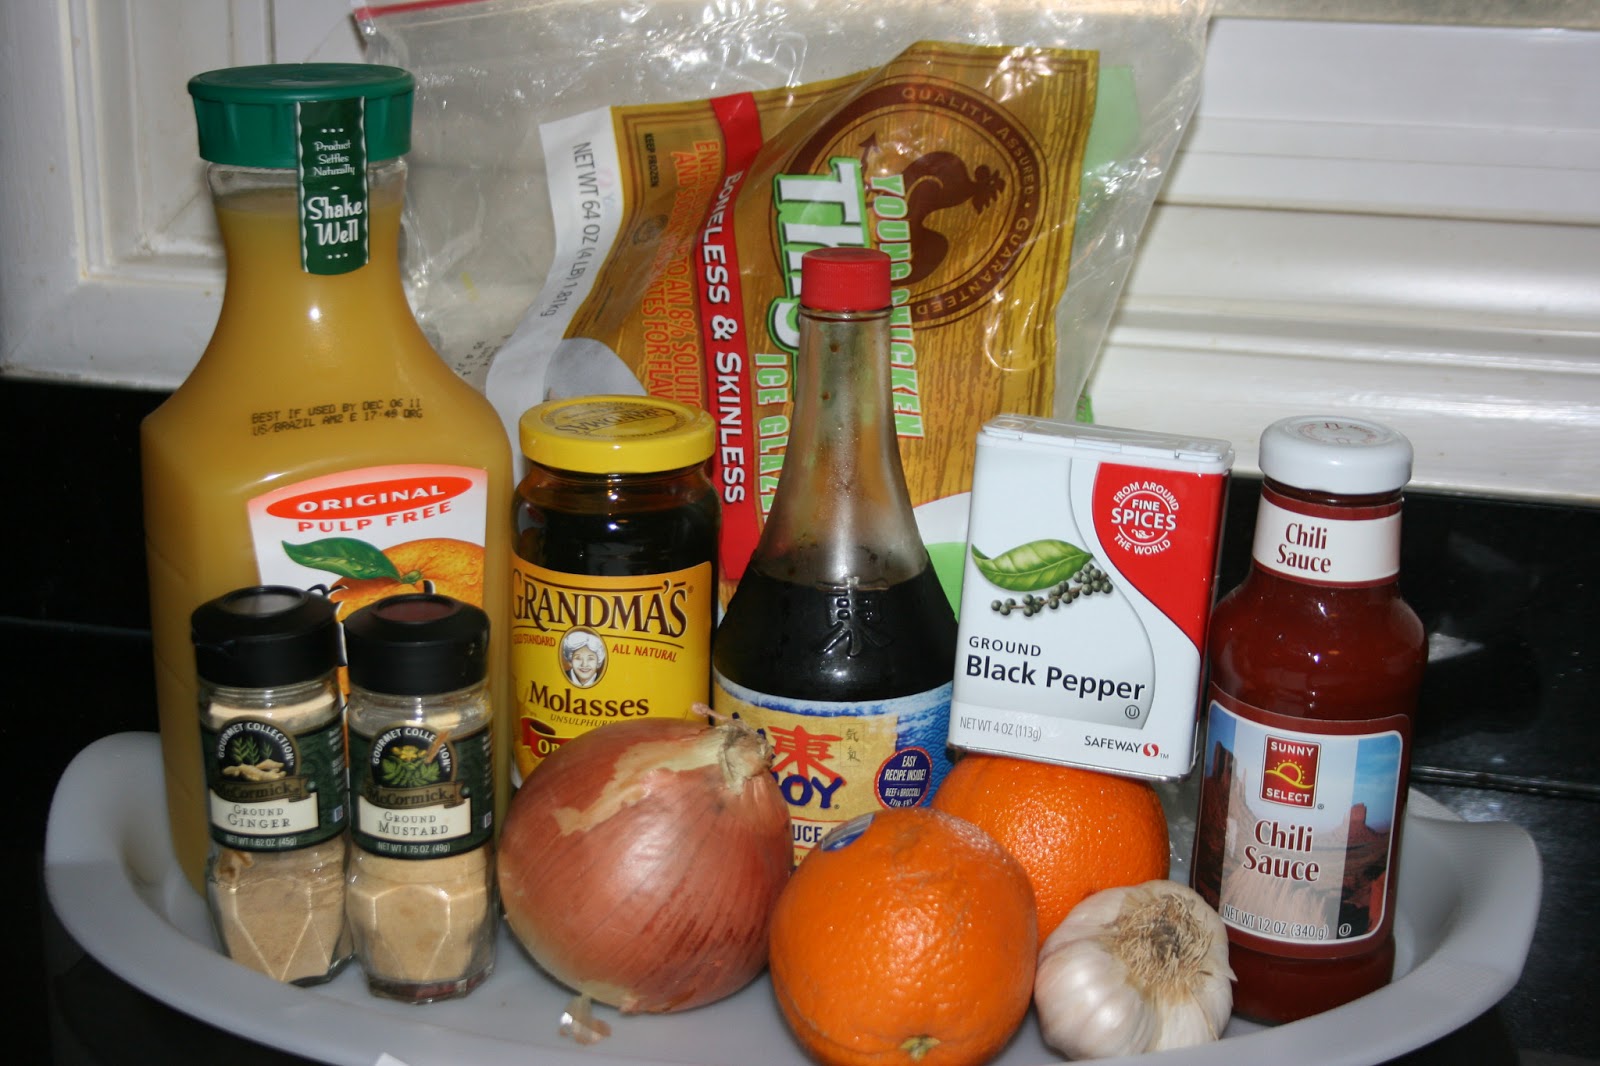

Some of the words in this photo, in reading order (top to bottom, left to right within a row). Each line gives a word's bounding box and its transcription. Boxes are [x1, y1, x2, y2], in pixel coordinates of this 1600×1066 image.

[313, 140, 351, 152] Product
[573, 142, 595, 168] NET
[644, 133, 656, 155] KEEP
[902, 86, 992, 123] QUALITY
[997, 126, 1035, 198] ASSURED
[313, 163, 356, 178] Naturally
[317, 153, 350, 166] Settles
[648, 155, 660, 188] FROZEN
[671, 151, 698, 187] AND
[578, 171, 599, 195] WT
[307, 194, 363, 221] Shake
[582, 200, 601, 220] 64
[313, 218, 359, 246] Well
[583, 225, 601, 248] OZ
[703, 170, 743, 304] BONELESS
[871, 175, 912, 282] YOUNG
[667, 255, 689, 276] TO
[916, 216, 1030, 315] GUARANTEED
[666, 279, 691, 304] AN
[668, 309, 696, 338] 8%
[711, 314, 739, 341] &
[643, 321, 671, 357] FOR
[672, 342, 702, 408] SOLUTI
[890, 289, 925, 438] CHICKEN
[647, 359, 671, 398] FLAV
[755, 353, 787, 406] ICE
[252, 410, 281, 424] BEST
[288, 408, 301, 420] IF
[308, 404, 336, 417] USED
[342, 403, 357, 413] BY
[362, 400, 384, 411] DEC
[715, 351, 747, 504] SKINLESS
[759, 415, 790, 523] GLAZ
[297, 485, 446, 514] ORIGINAL
[1113, 482, 1140, 503] FROM
[1142, 481, 1180, 511] AROUND
[1131, 498, 1161, 512] FINE
[297, 517, 374, 533] PULP
[386, 500, 453, 527] FREE
[1110, 507, 1177, 531] SPICES
[1113, 533, 1132, 552] THE
[1133, 539, 1171, 555] WORLD
[1285, 522, 1328, 550] Chili
[1276, 543, 1332, 574] Sauce
[511, 568, 688, 639] GRANDMA'S
[612, 643, 631, 656] ALL
[634, 645, 677, 663] NATURAL
[968, 635, 1042, 658] GROUND
[965, 653, 1037, 687] Black
[1046, 664, 1146, 701] Pepper
[529, 680, 650, 718] Molasses
[217, 722, 244, 758] GOURMET
[246, 722, 296, 761] COLLECTION
[960, 715, 978, 730] NET
[978, 717, 992, 732] WT
[993, 719, 1000, 733] 4
[1001, 720, 1014, 735] OZ
[1014, 721, 1042, 742] (113g)
[371, 728, 402, 765] GOURMET
[405, 727, 451, 767] COLLETION
[1084, 734, 1142, 755] SAFEWAY
[1270, 741, 1315, 757] SUNNY
[902, 755, 917, 767] EASY
[884, 769, 907, 781] RECIPE
[906, 769, 927, 781] INSIDE!
[368, 788, 450, 806] McCormick
[774, 772, 844, 809] OY
[1266, 787, 1310, 804] SELECT
[228, 813, 291, 829] GINGER
[233, 804, 284, 816] GROUND
[384, 811, 437, 824] GROUND
[238, 836, 250, 846] WT
[266, 837, 276, 847] OZ
[378, 821, 449, 837] MUSTARD
[793, 825, 823, 843] UCE
[1254, 819, 1314, 853] Chili
[378, 841, 390, 851] NET
[391, 843, 403, 853] WT
[420, 844, 430, 853] OZ
[432, 842, 451, 854] (49g)
[1242, 845, 1320, 883] Sauce
[1223, 903, 1240, 922] NET
[1241, 912, 1256, 927] WT
[1258, 917, 1272, 932] 12
[1273, 921, 1288, 935] OZ
